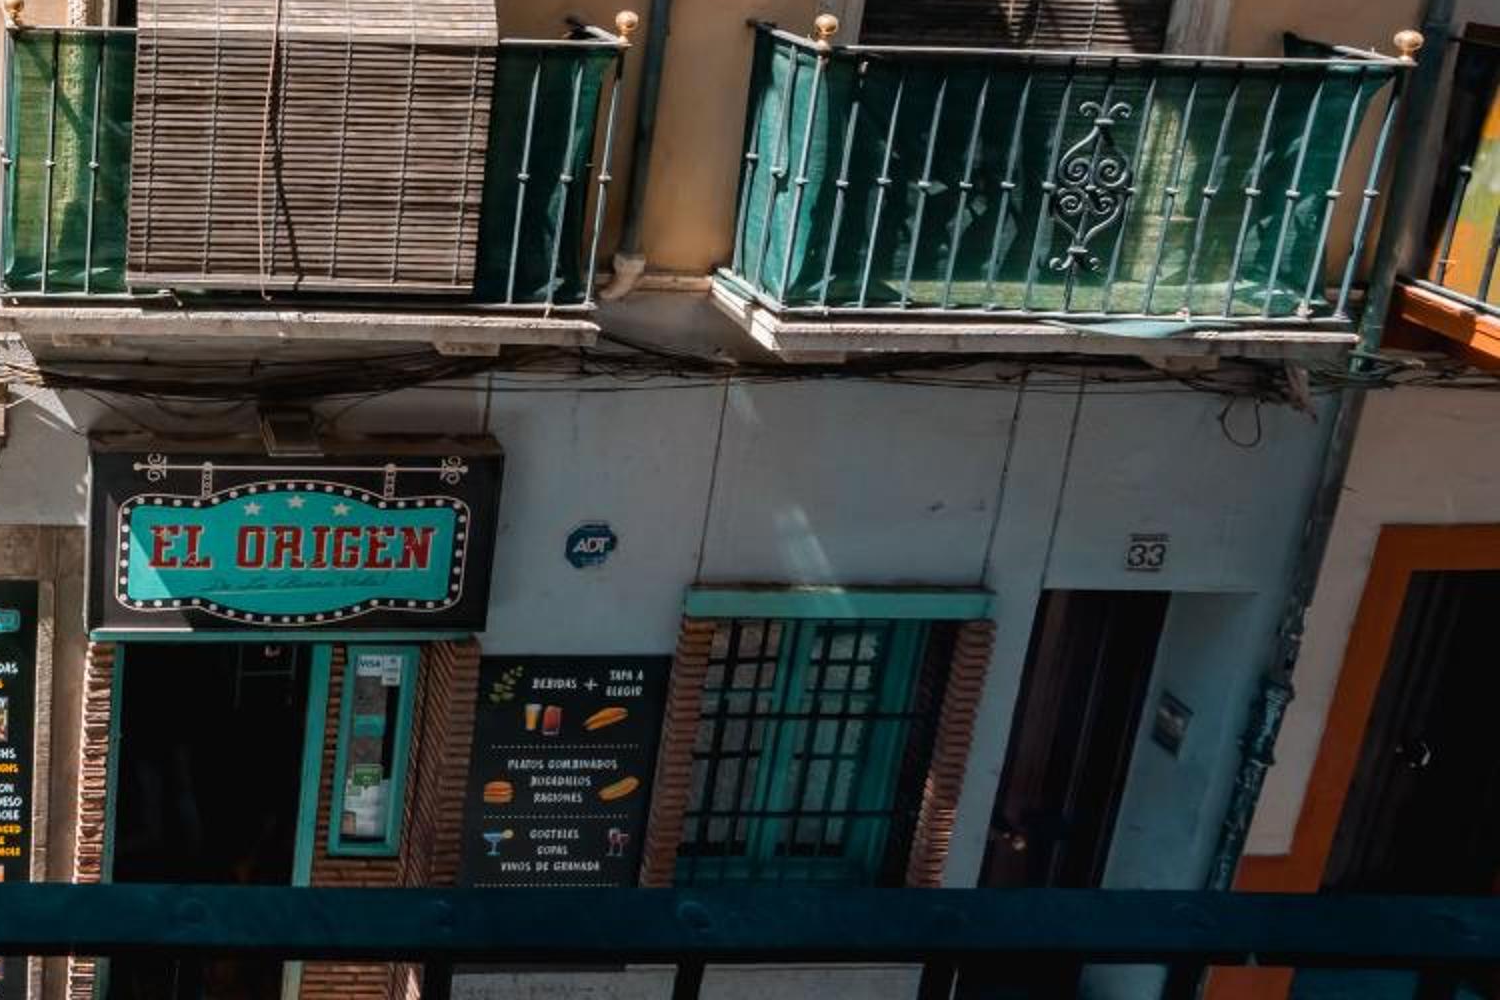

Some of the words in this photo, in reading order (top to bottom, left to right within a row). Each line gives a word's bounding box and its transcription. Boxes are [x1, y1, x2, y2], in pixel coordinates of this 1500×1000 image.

[148, 524, 212, 570] EL
[235, 524, 437, 571] ORIGEN
[572, 537, 610, 553] ADT
[1127, 543, 1167, 567] 33
[609, 669, 634, 681] TAPA
[637, 669, 644, 681] A
[531, 677, 578, 689] BEBIDAS
[606, 685, 643, 697] ELEGIR
[507, 758, 544, 770] PLATOS
[547, 758, 618, 770] COMBINADOS
[529, 775, 592, 787] BOCADILLOS
[533, 792, 583, 804] RACIONES
[537, 845, 569, 856] COPAS
[500, 861, 532, 872] VINOS
[535, 861, 551, 872] DE
[553, 861, 601, 872] GRANADA
